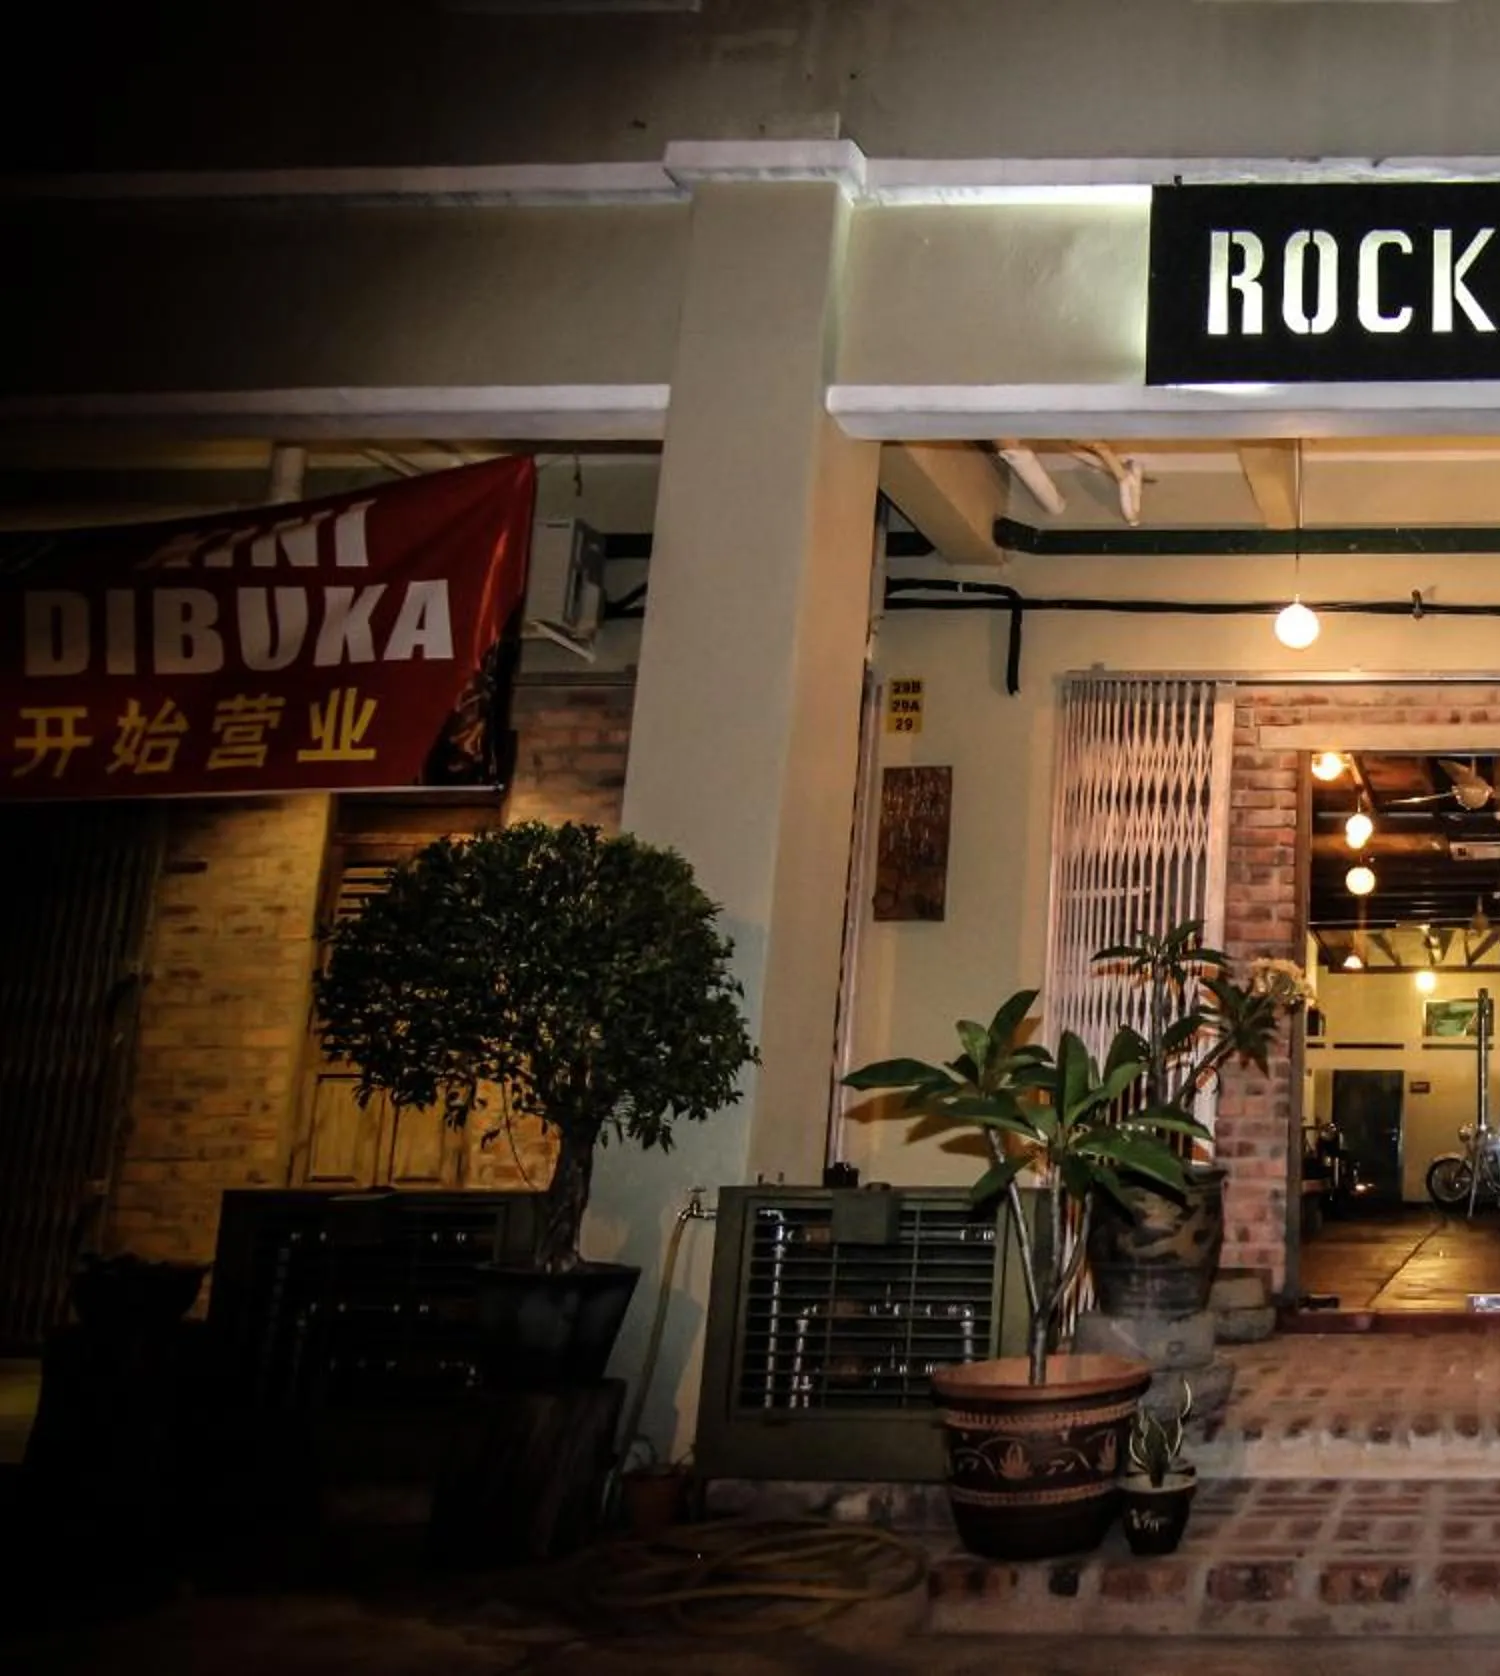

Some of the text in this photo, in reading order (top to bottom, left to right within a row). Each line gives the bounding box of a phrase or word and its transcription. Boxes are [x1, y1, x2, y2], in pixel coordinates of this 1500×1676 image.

[1206, 228, 1498, 336] ROCK
[23, 579, 455, 678] DIBUKA
[10, 687, 378, 779] 开始营业
[895, 718, 913, 731] 29
